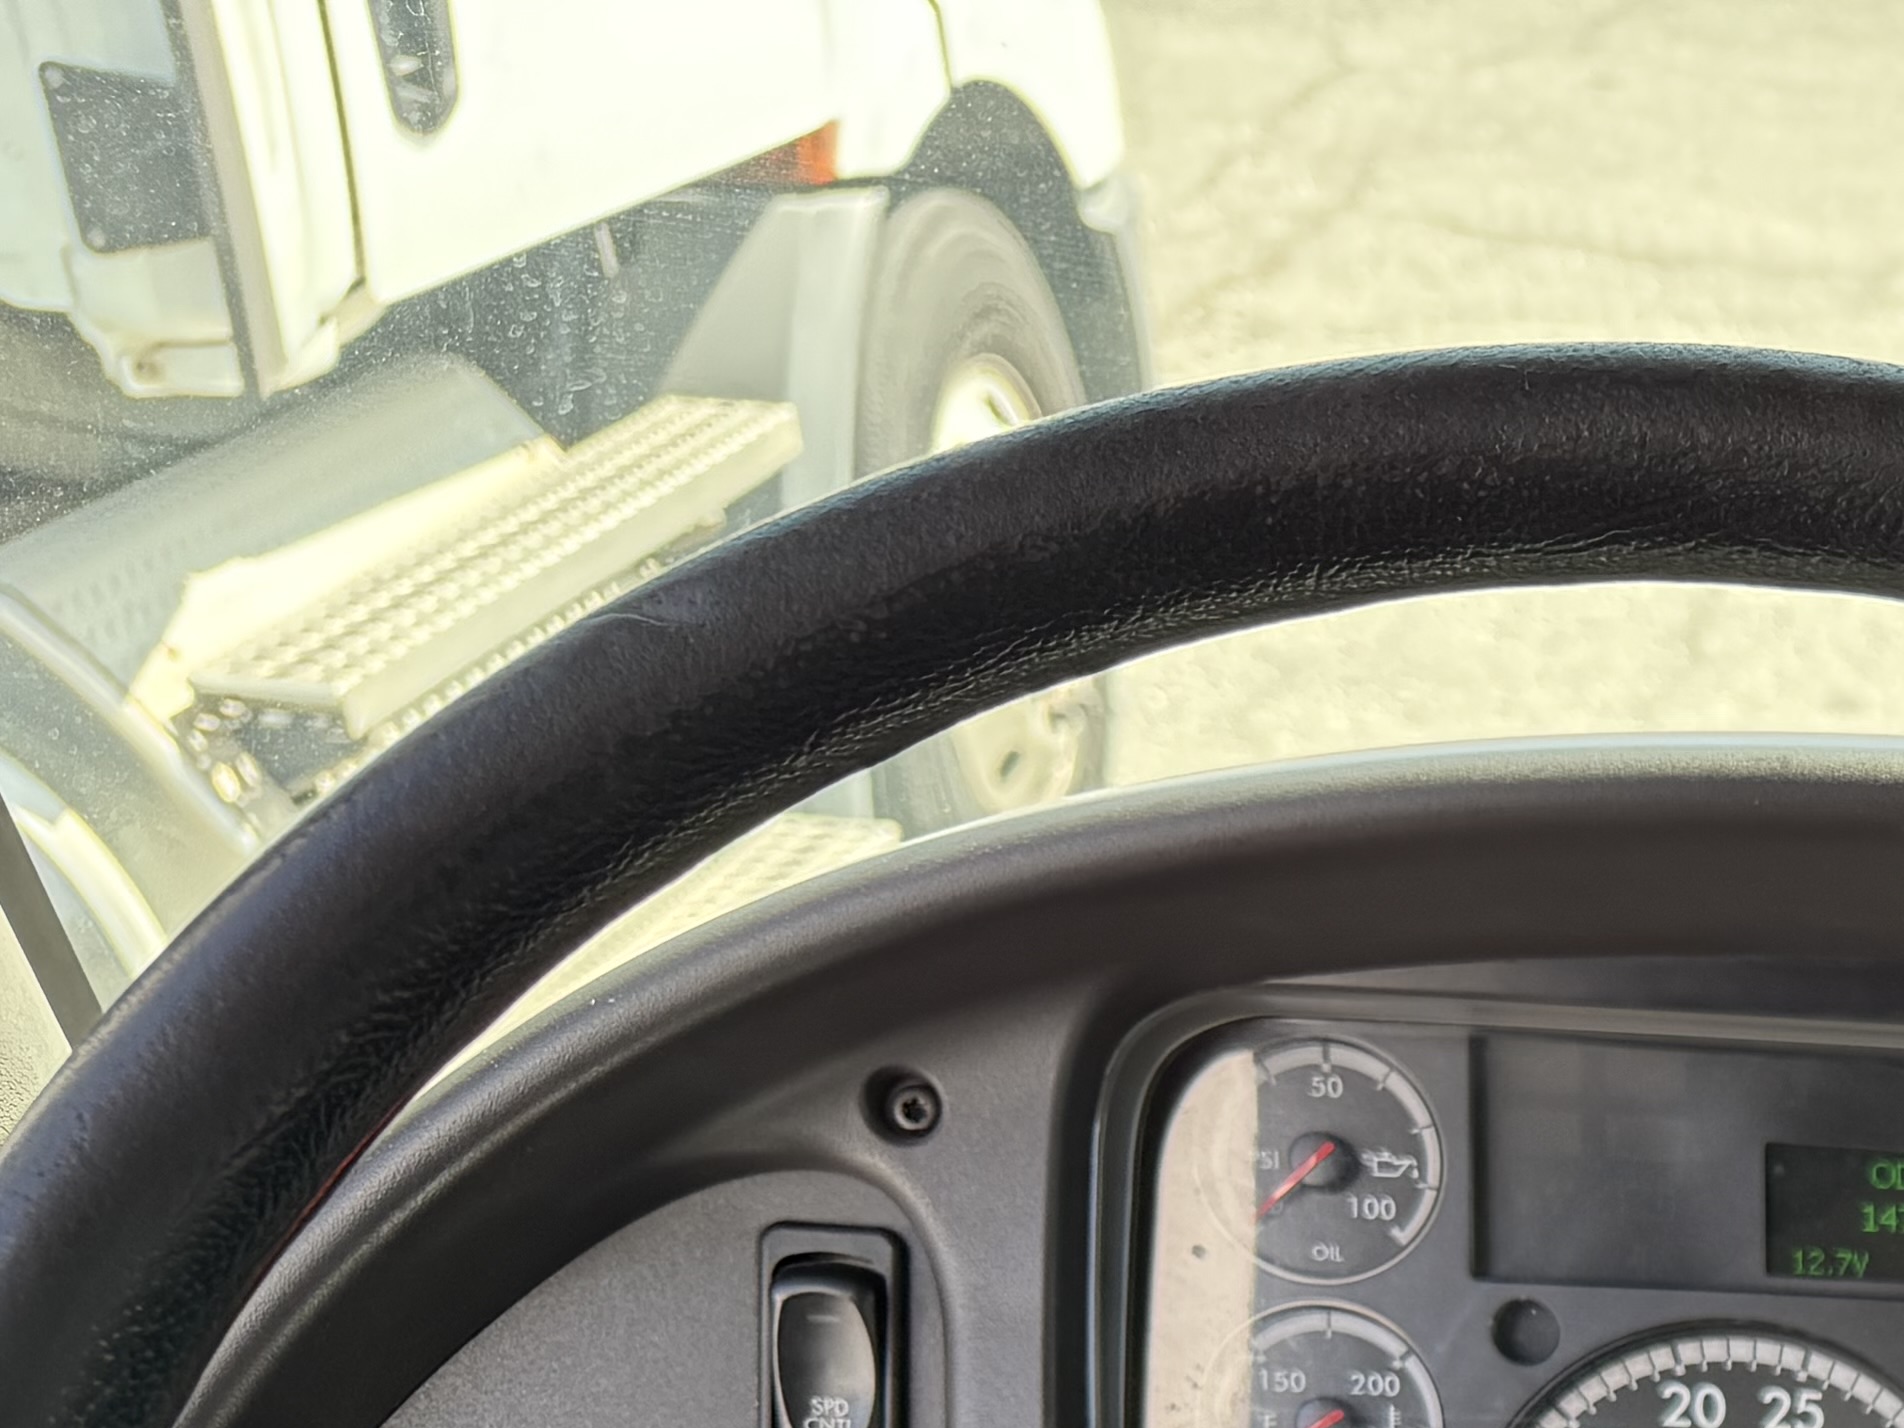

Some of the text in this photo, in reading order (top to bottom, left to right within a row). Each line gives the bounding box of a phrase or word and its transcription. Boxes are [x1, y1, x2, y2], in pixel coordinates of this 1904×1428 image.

[1308, 1076, 1344, 1099] 50
[1347, 1195, 1397, 1221] 100
[1312, 1243, 1344, 1262] OIL
[1793, 1248, 1870, 1278] 12.7V
[1259, 1369, 1307, 1393] 150
[1350, 1371, 1401, 1397] 200
[810, 1396, 849, 1419] SPD
